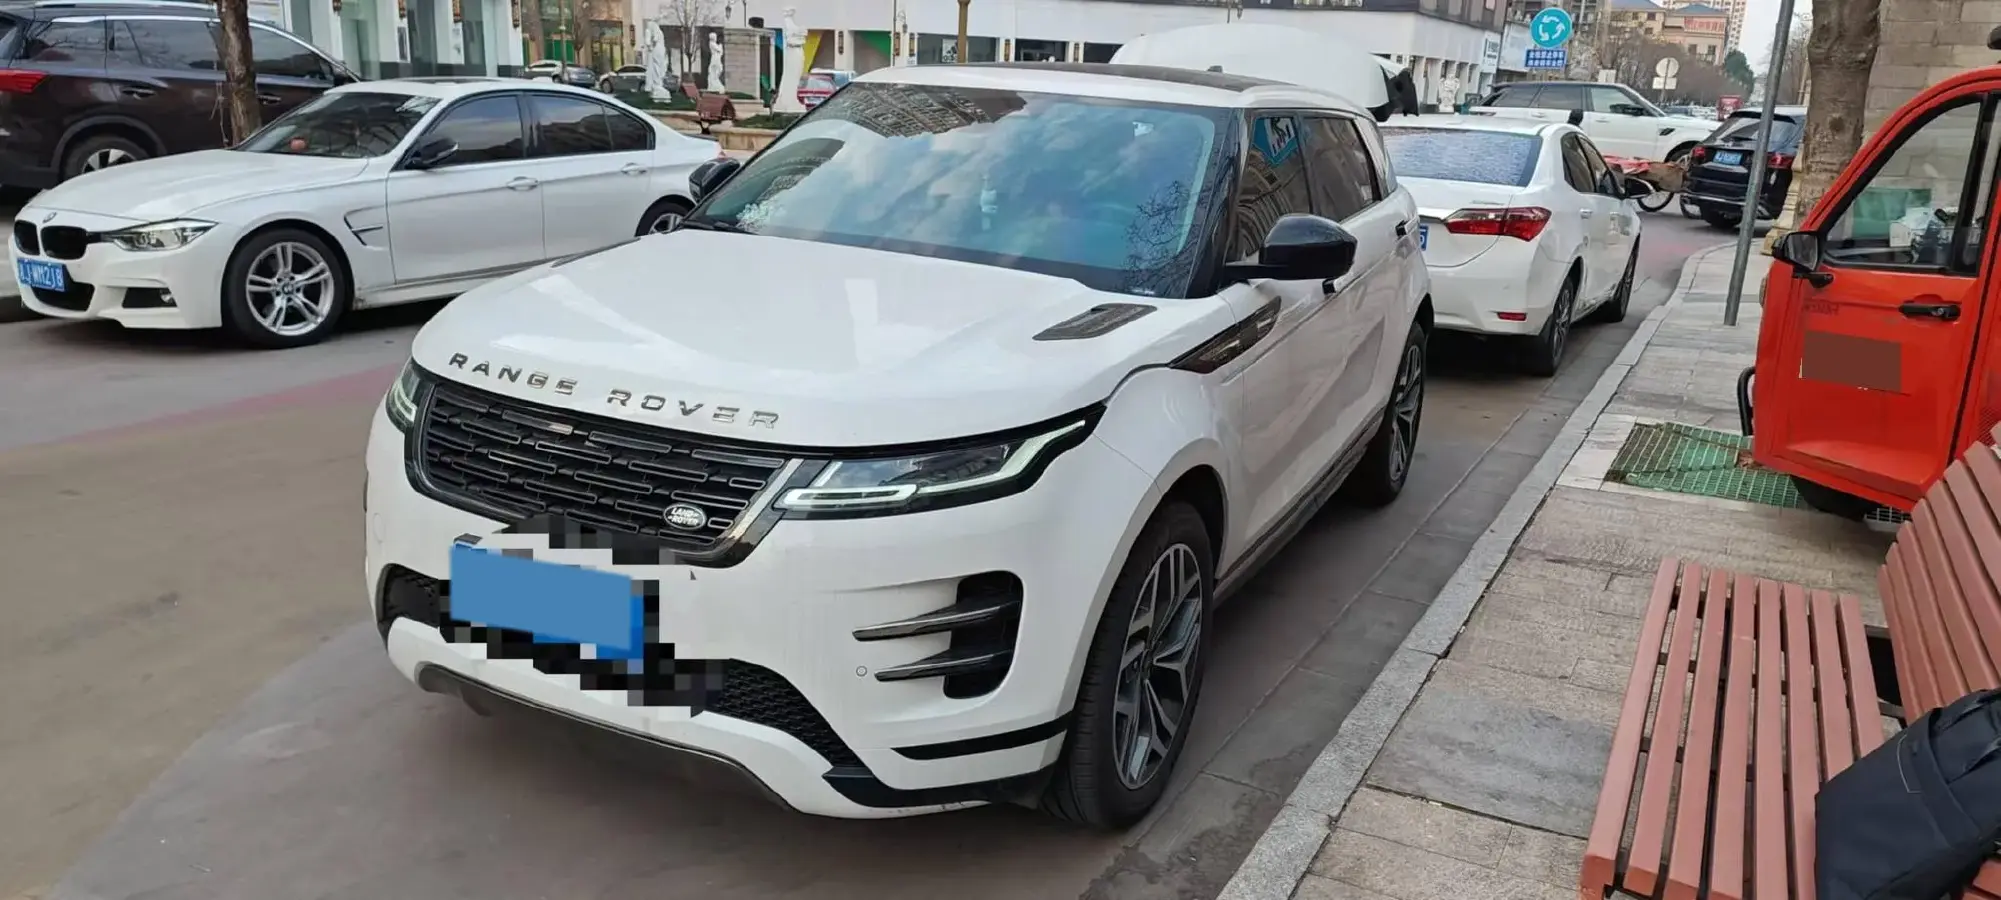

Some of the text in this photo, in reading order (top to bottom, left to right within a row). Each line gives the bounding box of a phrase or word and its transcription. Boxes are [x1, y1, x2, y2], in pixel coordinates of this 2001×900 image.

[448, 351, 780, 429] RANGE ROVER
[671, 507, 695, 517] LAND
[671, 515, 699, 526] ROVER
